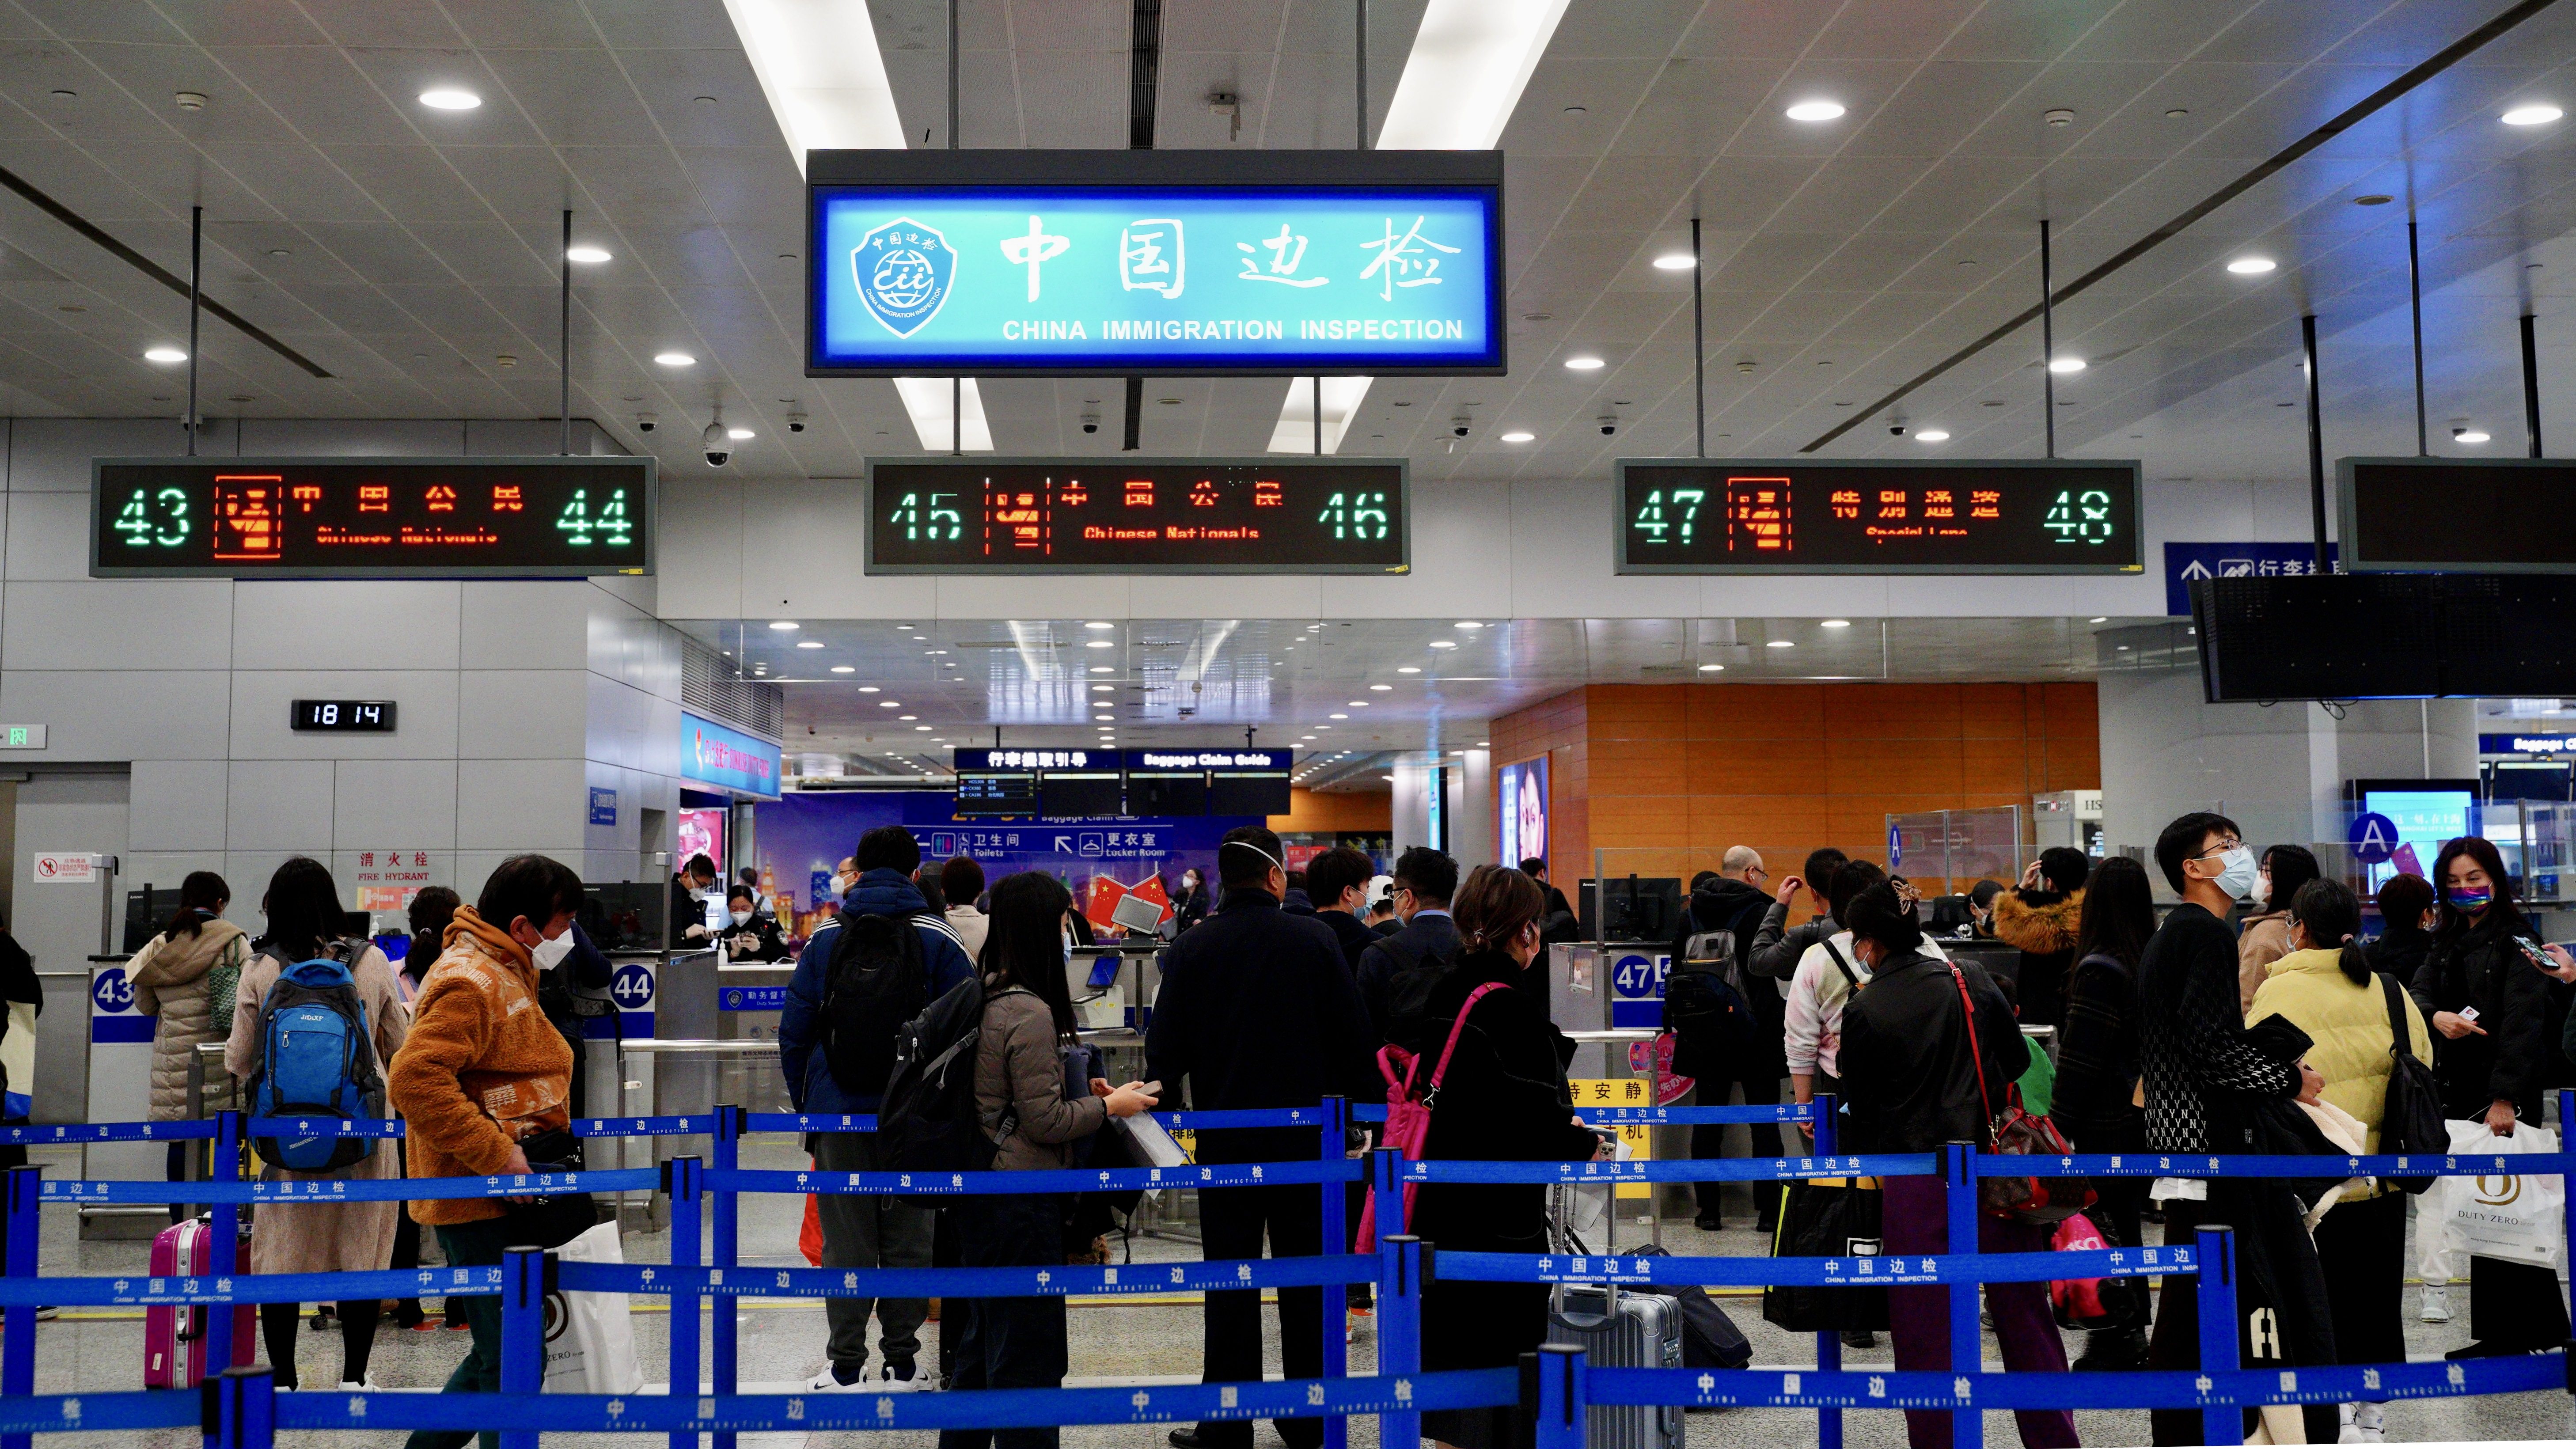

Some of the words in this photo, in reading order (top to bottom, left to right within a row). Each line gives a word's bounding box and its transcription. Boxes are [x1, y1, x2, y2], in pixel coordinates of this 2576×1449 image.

[872, 231, 938, 250] 中国边检
[1000, 215, 1461, 302] 中国边检
[866, 288, 877, 306] CHINA
[876, 303, 915, 318] IMMIGRATION
[915, 287, 941, 315] INSPECTION
[1002, 320, 1087, 340] CHINA
[1102, 320, 1282, 340] IMMIGRATION
[1301, 320, 1463, 340] INSPECTION
[115, 489, 190, 545] 43
[557, 489, 631, 545] 44
[1635, 490, 1704, 544] 47
[1085, 527, 1157, 539] Chinese
[1167, 527, 1260, 539] Nationals
[314, 704, 338, 724] 18
[355, 706, 379, 723] 14
[1144, 754, 1196, 767] Baggage
[1199, 754, 1233, 765] Claim
[1235, 754, 1271, 766] Guide
[974, 833, 1019, 846] 卫生间
[1107, 833, 1156, 846] 更衣室
[2358, 820, 2388, 853] A
[975, 848, 1003, 857] Toilets
[1106, 848, 1138, 857] Locker
[1892, 831, 1899, 860] A
[360, 851, 428, 867] 消火栓
[385, 872, 430, 880] HYDRANT
[1617, 965, 1650, 989] 47
[98, 978, 133, 1004] 43
[615, 974, 650, 998] 44
[1597, 1108, 1667, 1118] 中国边检
[1561, 1162, 1645, 1174] 中国边检
[1776, 1157, 1860, 1170] 中国边检
[254, 1182, 345, 1193] 中国边检
[488, 1173, 577, 1187] 中国边检
[2458, 1210, 2487, 1221] DUTY
[2490, 1215, 2519, 1226] ZERO
[1539, 1257, 1650, 1273] 中国边检
[1825, 1258, 1936, 1274] 中国边检
[114, 1278, 232, 1293] 中国边检
[547, 1351, 571, 1362] ZERO
